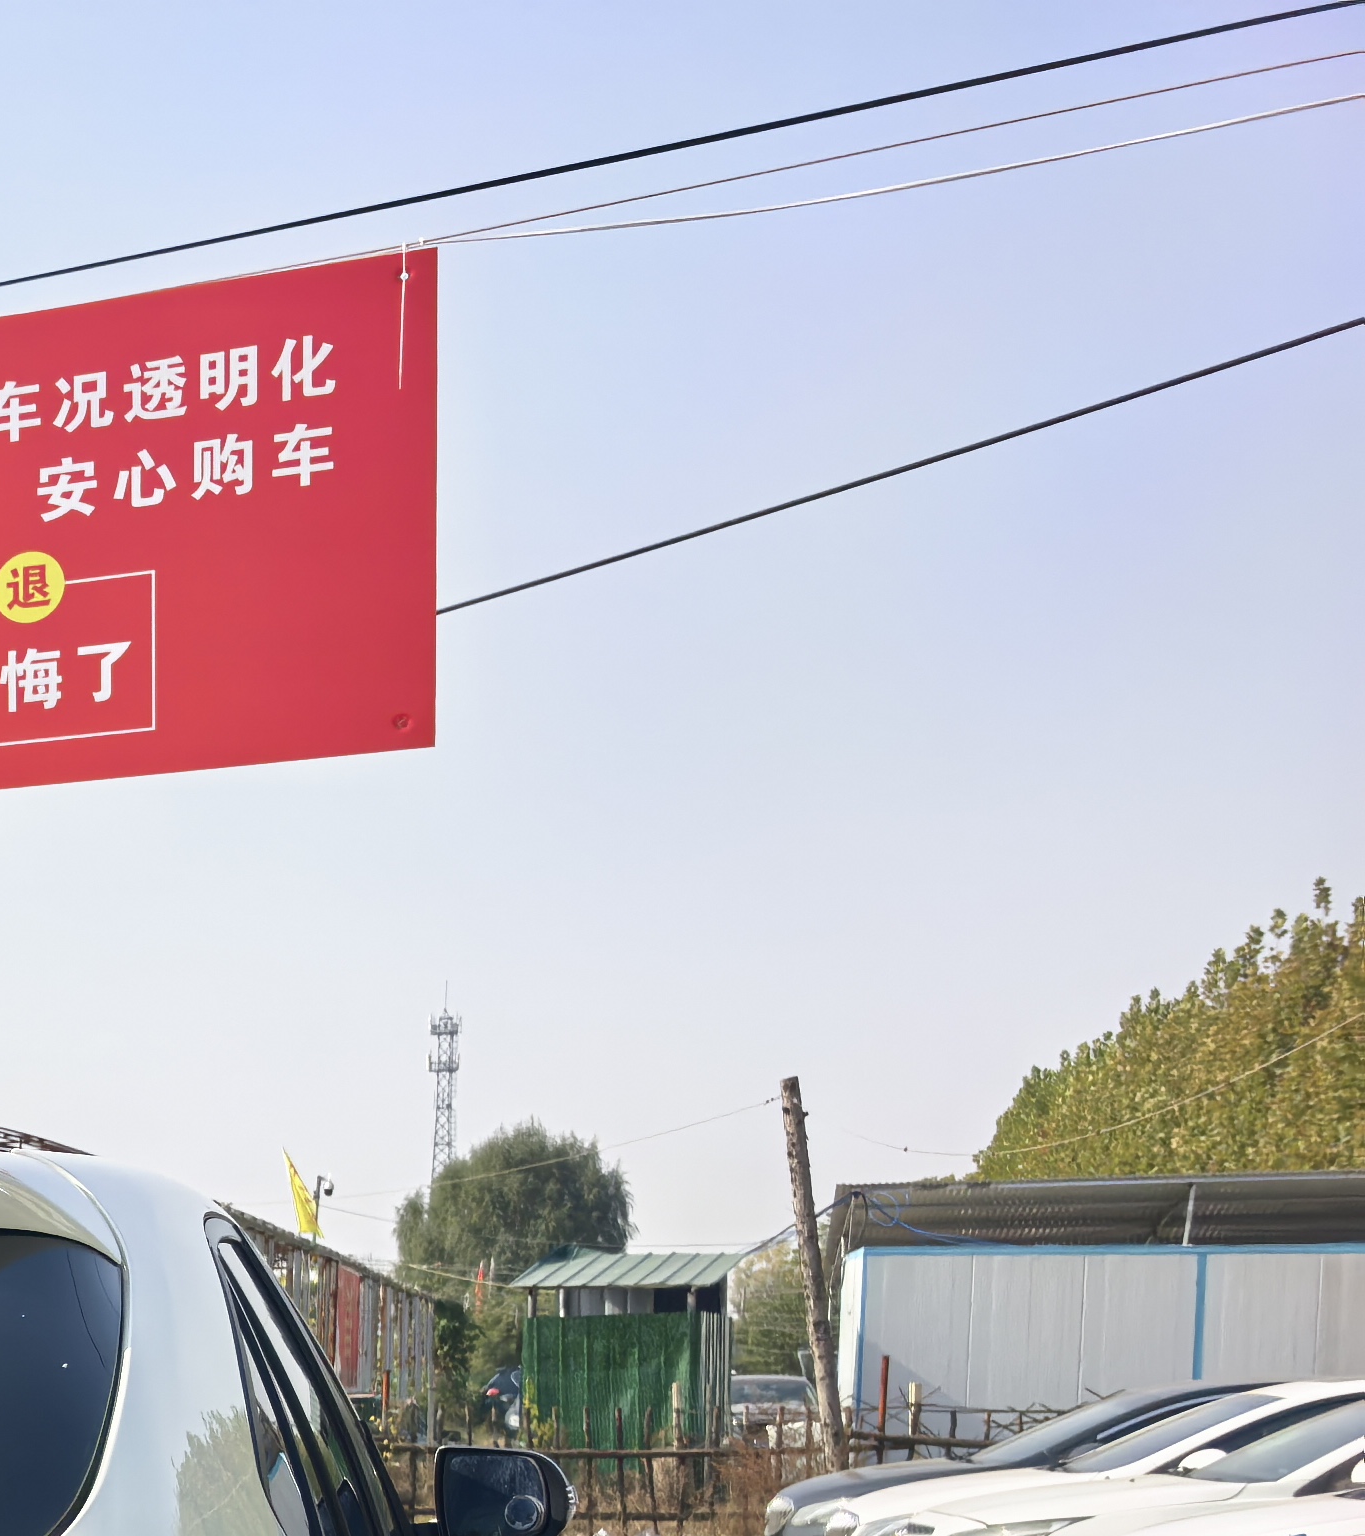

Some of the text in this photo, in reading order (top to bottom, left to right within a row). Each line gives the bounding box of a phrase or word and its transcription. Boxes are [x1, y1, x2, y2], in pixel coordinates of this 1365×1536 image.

[37, 424, 334, 522] 安心购车
[7, 565, 50, 610] 退
